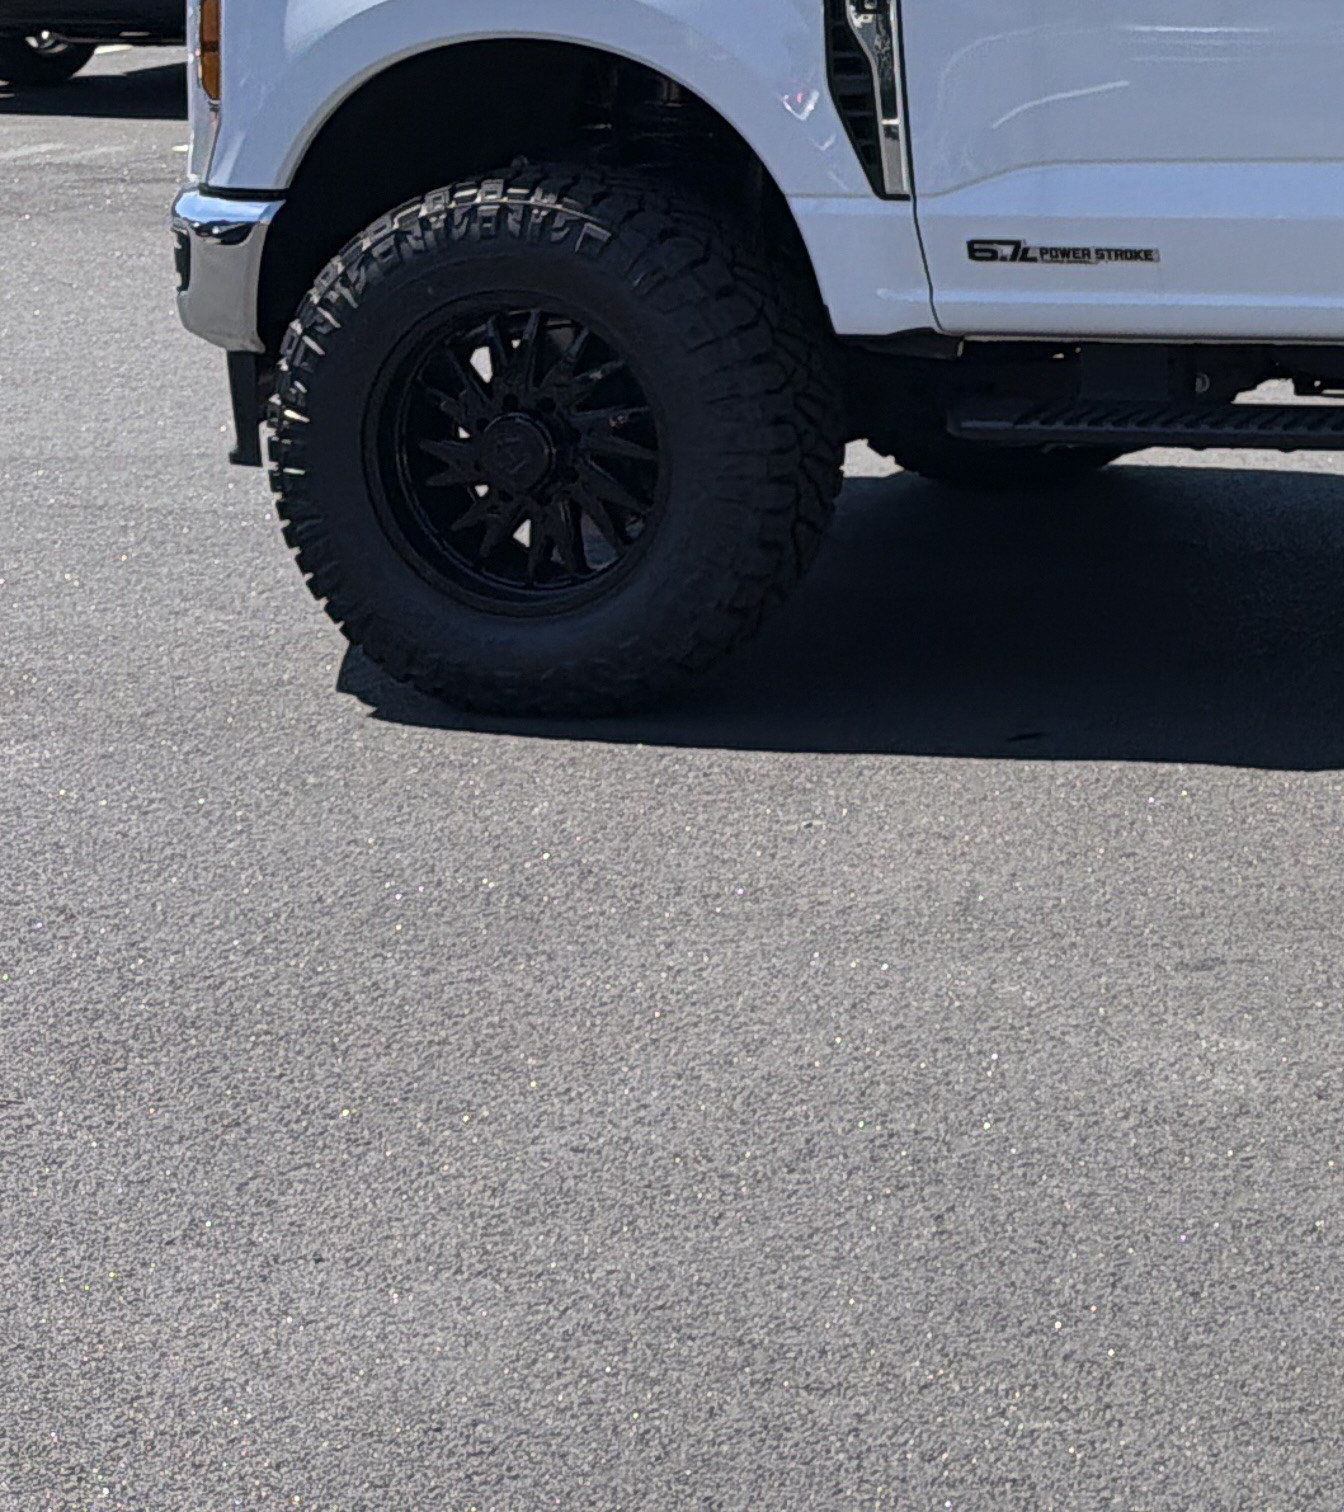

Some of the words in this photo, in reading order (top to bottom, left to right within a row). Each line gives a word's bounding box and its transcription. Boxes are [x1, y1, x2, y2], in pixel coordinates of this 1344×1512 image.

[966, 239, 1038, 263] 6.7L
[1040, 247, 1091, 261] POWER
[1095, 248, 1155, 262] STROKE
